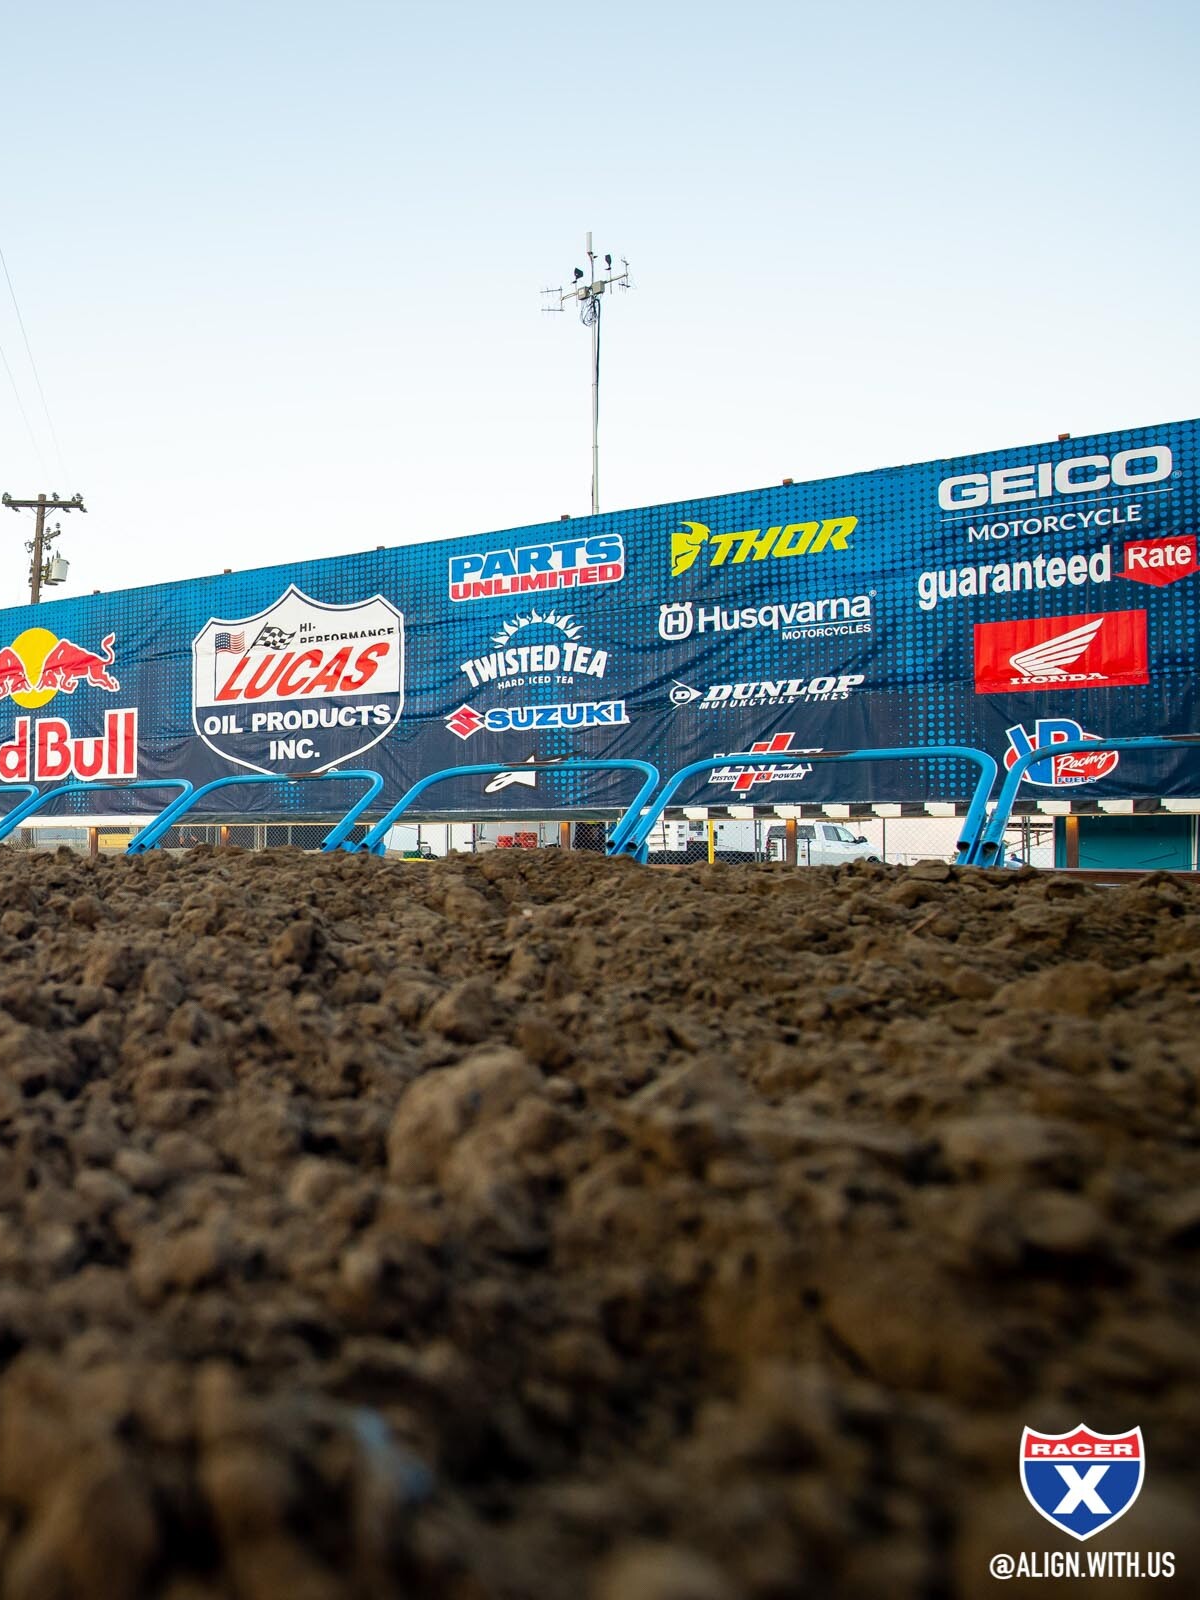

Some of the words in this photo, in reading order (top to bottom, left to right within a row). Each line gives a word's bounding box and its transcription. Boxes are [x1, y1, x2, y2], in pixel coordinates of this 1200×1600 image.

[938, 446, 1172, 511] GEICO
[968, 505, 1141, 543] MOTORCYCLE
[710, 515, 859, 567] THOR
[451, 534, 623, 584] PARTS
[451, 563, 622, 600] UNLIMITED
[918, 545, 1111, 610] guaranteed
[1128, 544, 1191, 571] Rate
[698, 595, 871, 635] Husqvarna
[300, 627, 394, 643] PERFORMANCE
[781, 624, 872, 640] MOTORCYCLES
[214, 642, 392, 702] LUCAS
[460, 645, 561, 688] TWISTED
[563, 642, 608, 678] TEA
[1010, 673, 1109, 685] HONDA
[498, 678, 525, 689] HARD
[528, 676, 551, 685] ICED
[556, 675, 574, 685] TEA
[702, 674, 865, 701] DUNLOP
[486, 702, 626, 731] SUZUKI
[699, 694, 795, 710] MOTORCYCLE
[204, 715, 243, 735] OIL
[252, 705, 392, 733] PRODUCTS
[35, 709, 137, 781] Bull
[269, 739, 321, 760] INC.
[1057, 752, 1109, 776] Racing
[1057, 776, 1097, 784] FUELS
